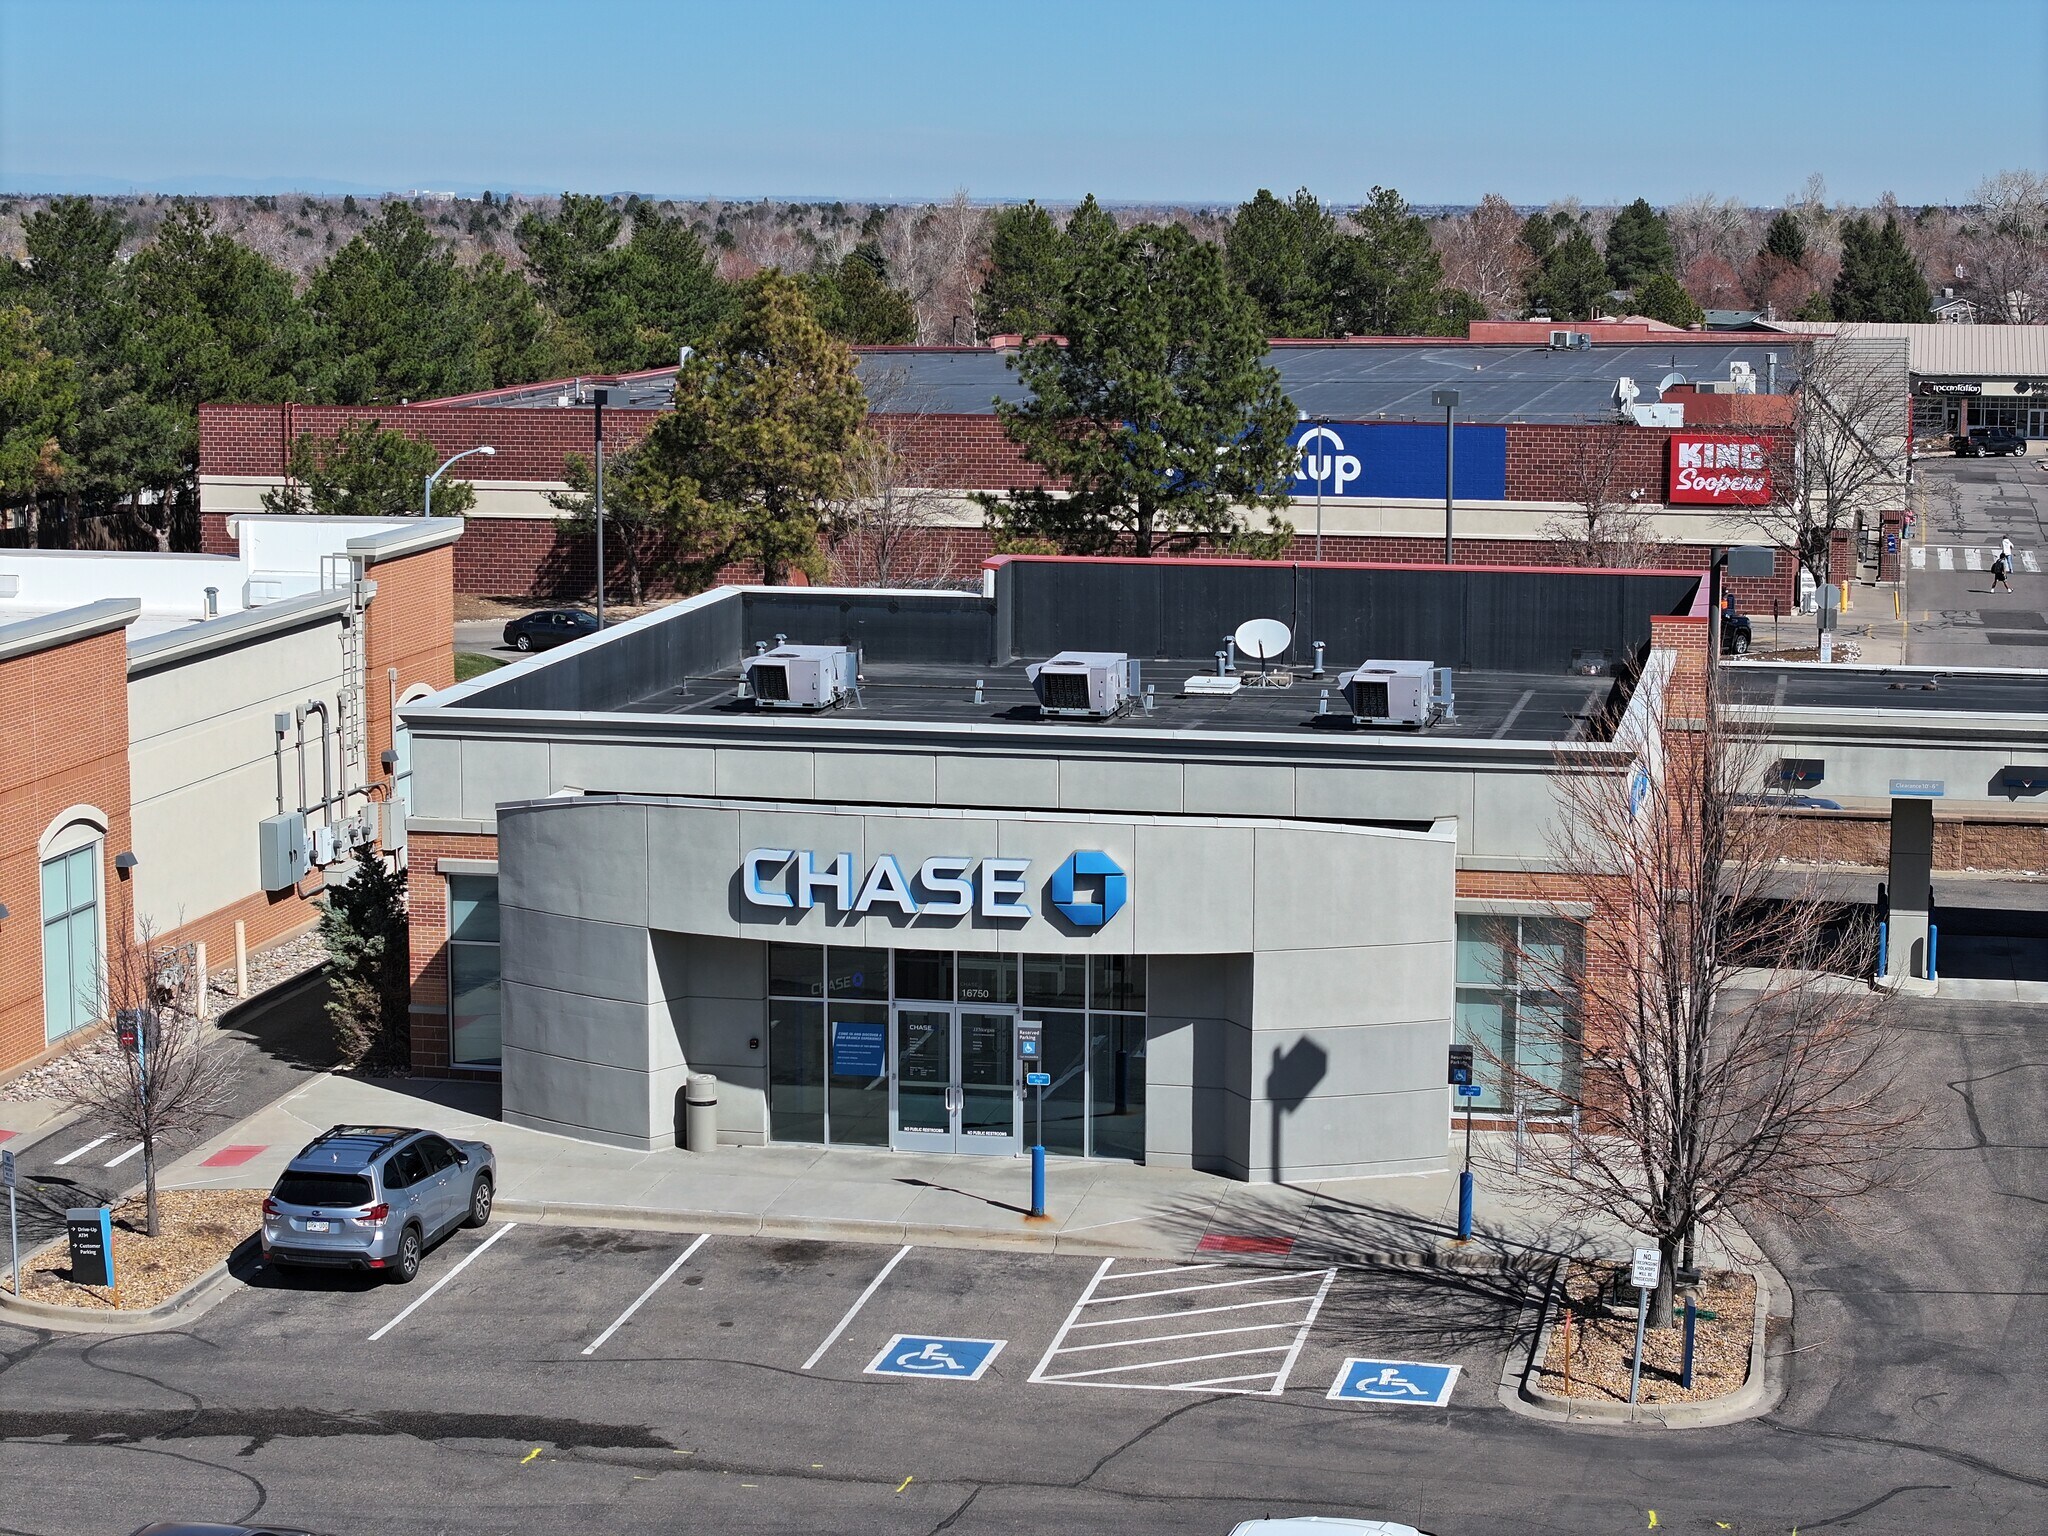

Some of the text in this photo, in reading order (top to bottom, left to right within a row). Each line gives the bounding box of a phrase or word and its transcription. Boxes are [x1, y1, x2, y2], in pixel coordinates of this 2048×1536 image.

[1678, 442, 1764, 469] KING
[1675, 467, 1765, 497] Soopers
[743, 847, 1032, 918] CHASE
[811, 976, 850, 995] CHASE
[961, 989, 989, 998] 16750
